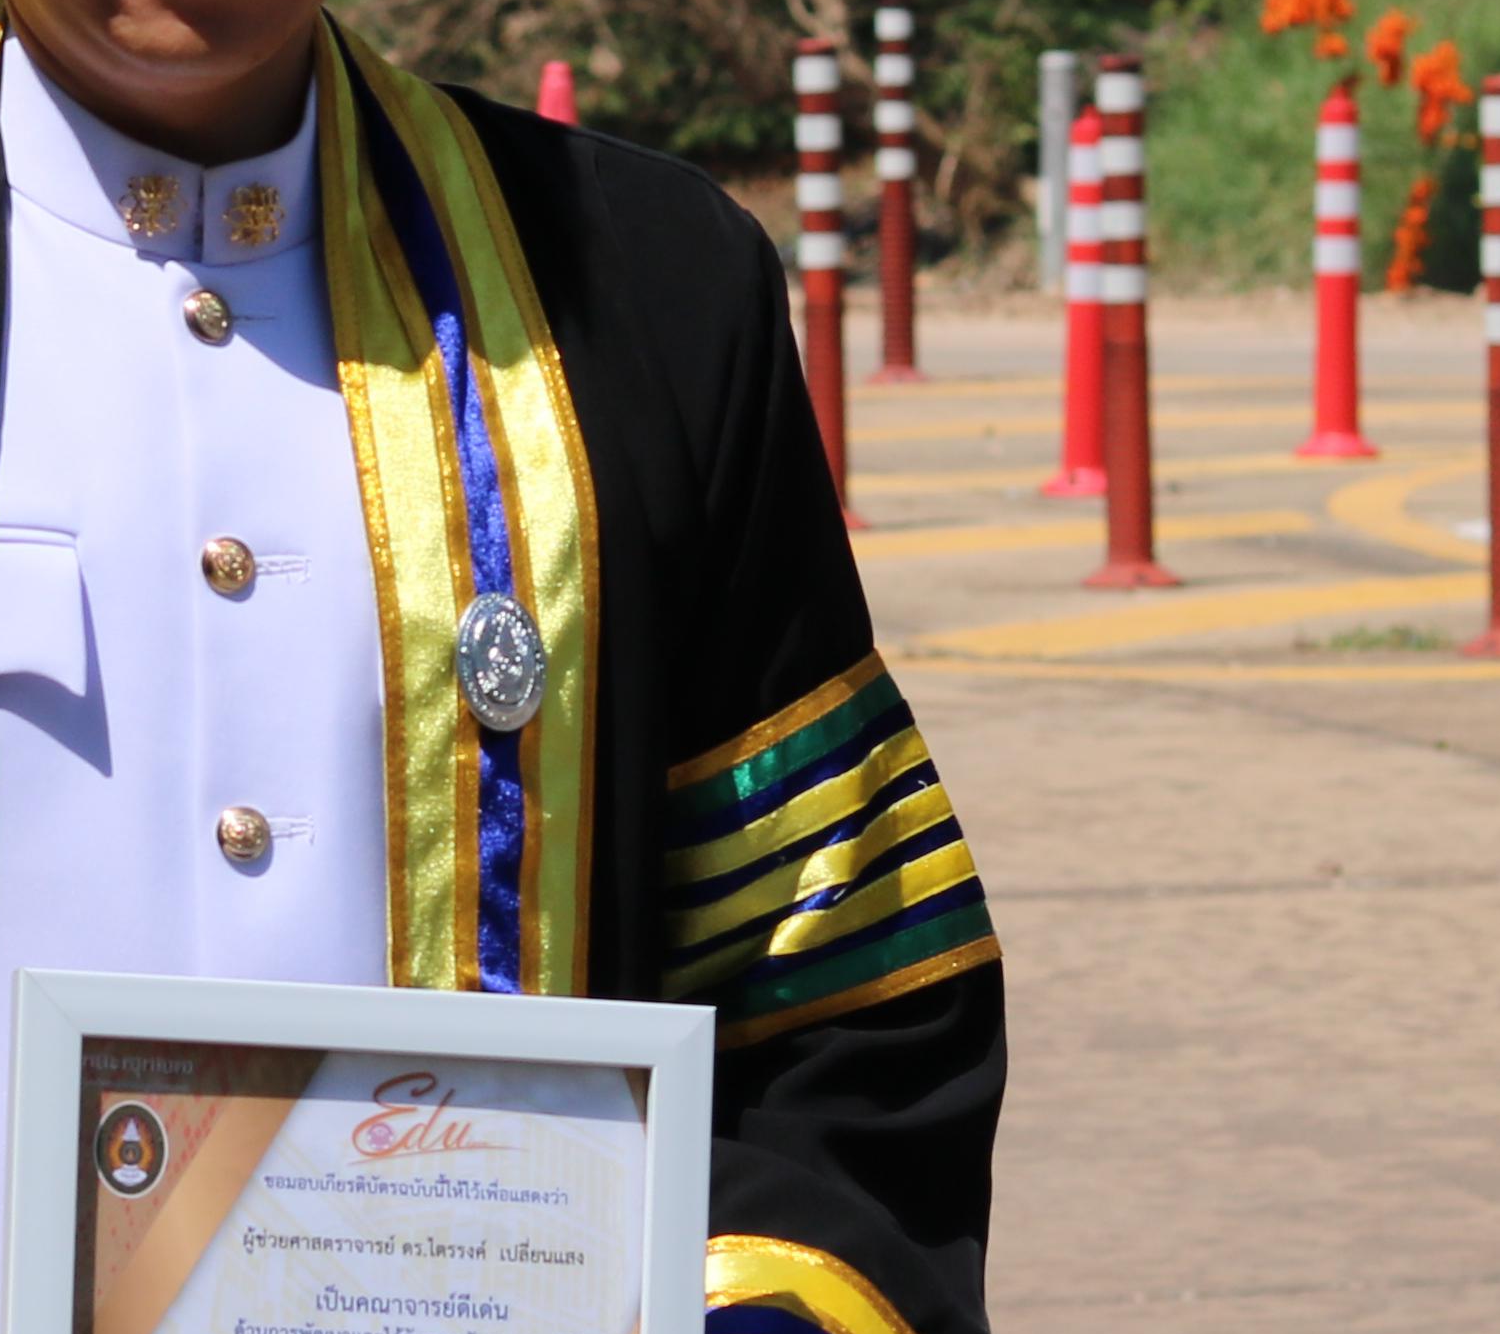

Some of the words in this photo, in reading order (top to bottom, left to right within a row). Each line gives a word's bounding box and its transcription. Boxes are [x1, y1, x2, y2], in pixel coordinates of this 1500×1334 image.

[352, 1071, 471, 1158] Edu
[264, 1173, 569, 1206] ขอมอบเกียรติบัตรฉบับนี้ให้ไว้เพื่อแสดงว่า
[243, 1226, 396, 1256] ผู้ช่วยศาสตราจารย์
[500, 1238, 585, 1266] เปลี่ยนแสง
[315, 1286, 509, 1321] เป็นคณาจารย์ดีเด่น
